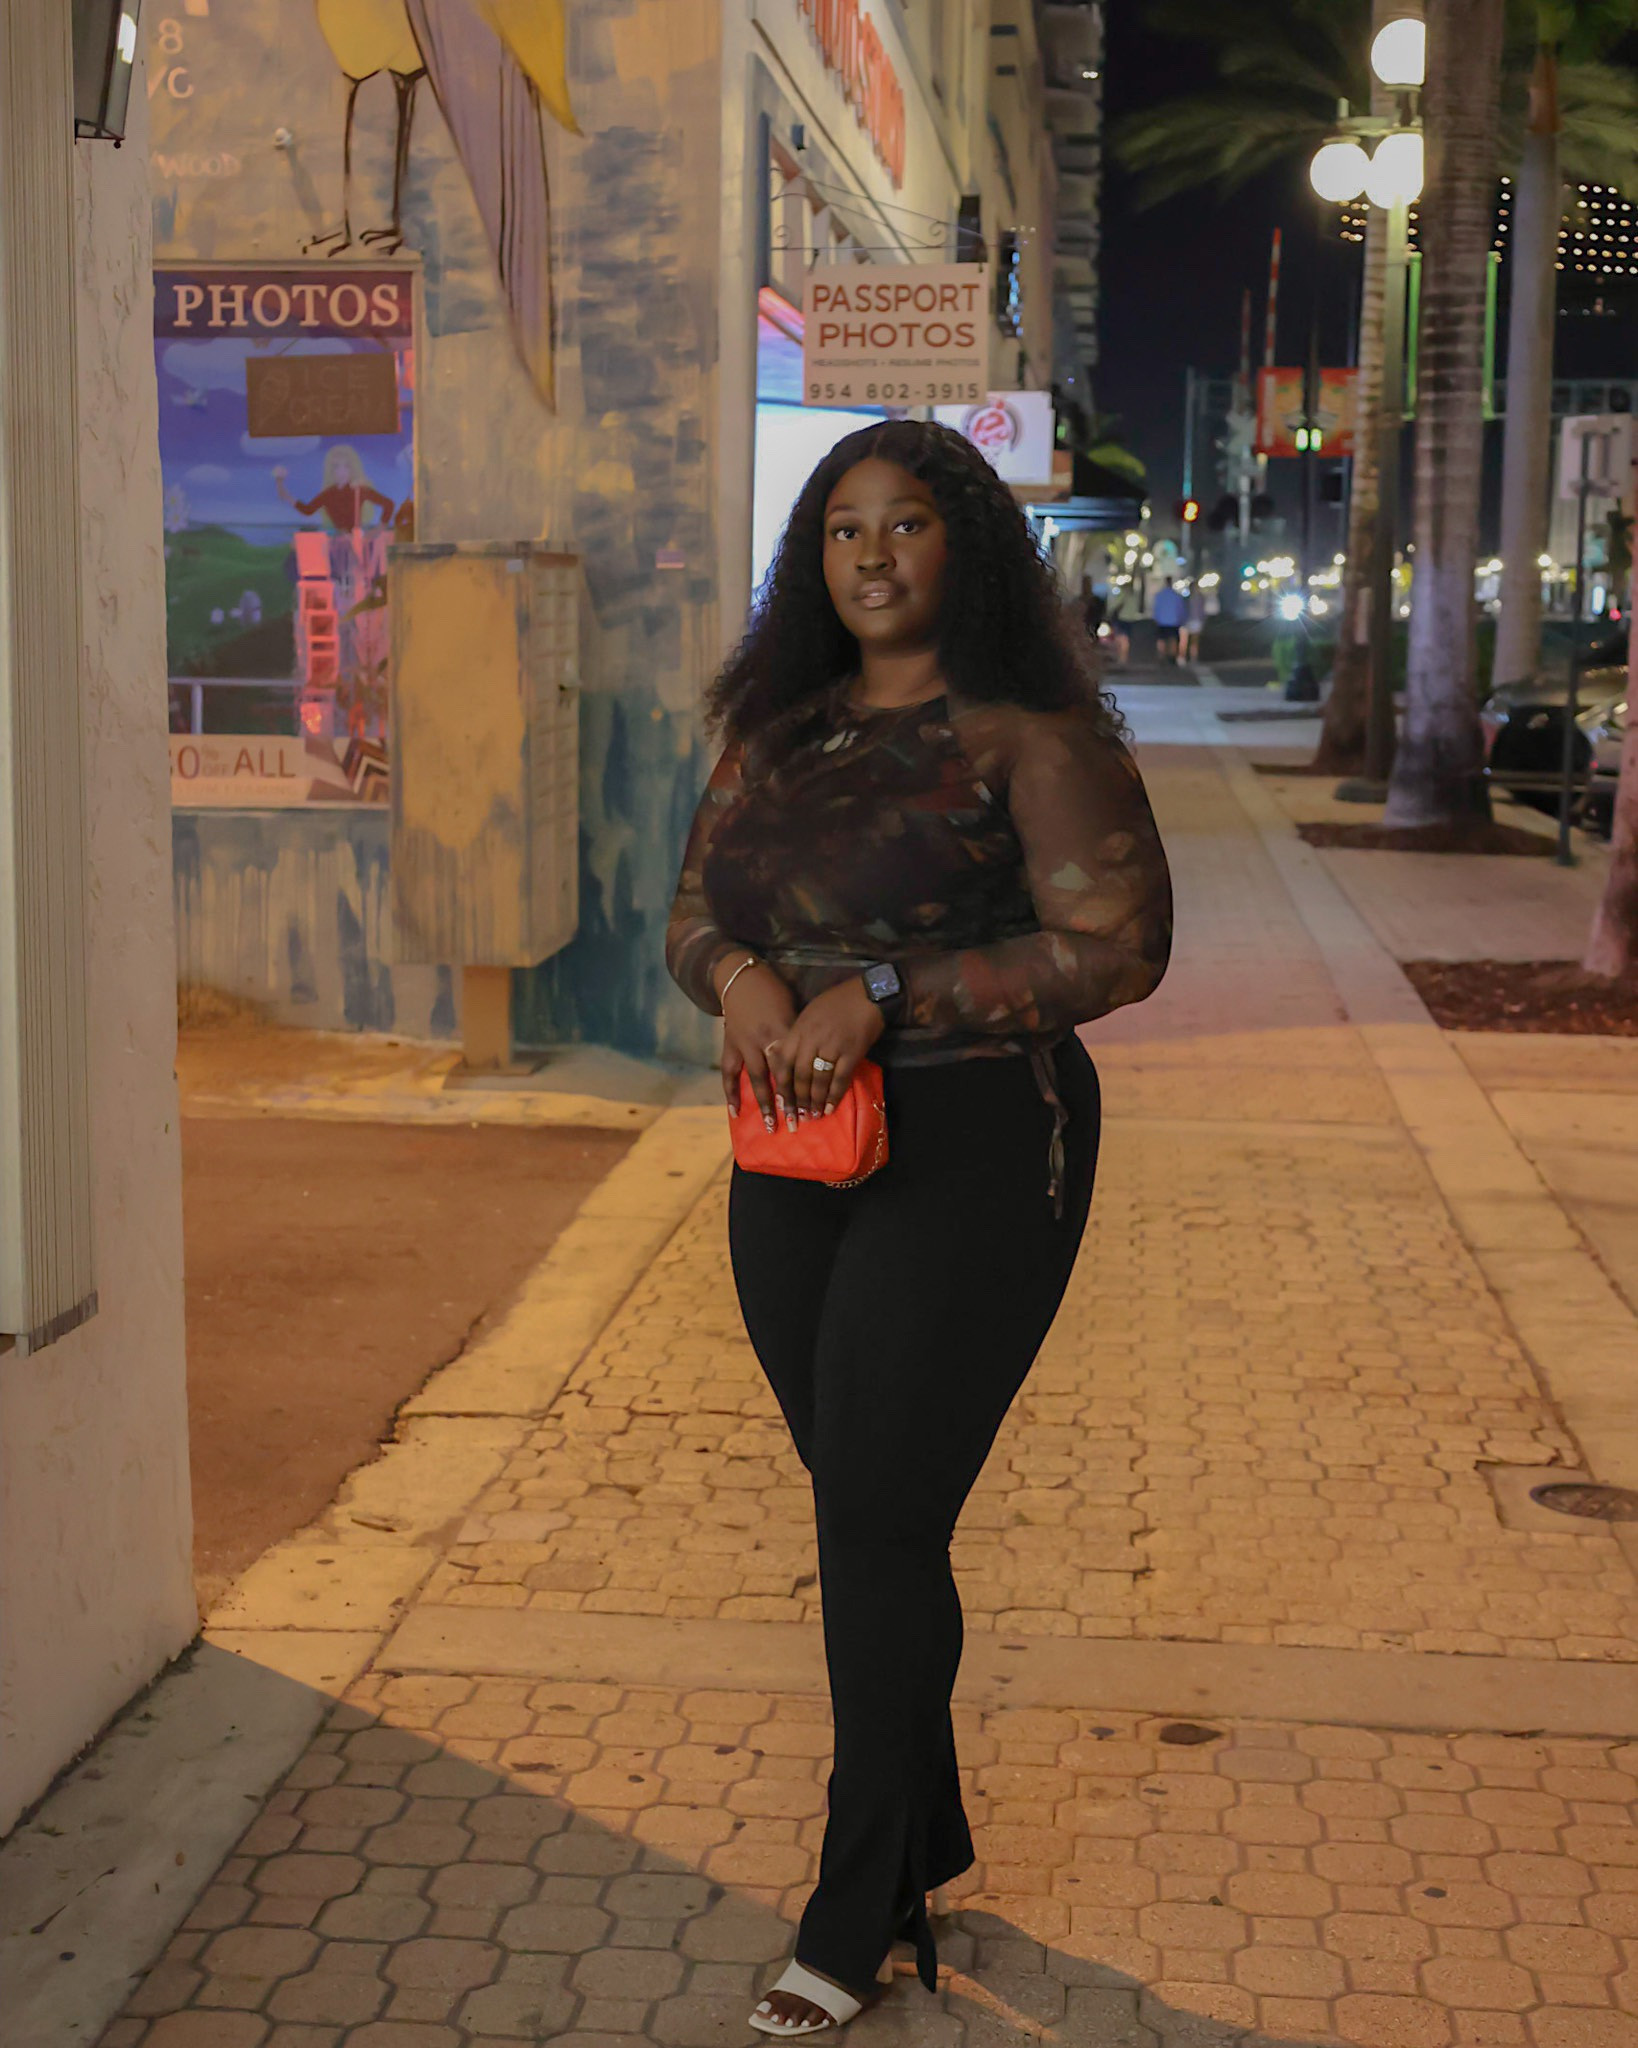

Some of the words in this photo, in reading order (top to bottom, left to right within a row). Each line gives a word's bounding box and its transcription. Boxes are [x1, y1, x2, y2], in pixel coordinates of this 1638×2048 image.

[172, 283, 401, 328] PHOTOS
[812, 283, 980, 313] PASSPORT
[818, 322, 976, 348] PHOTOS
[304, 363, 369, 391] ICE
[808, 383, 853, 399] 954
[866, 383, 979, 399] 802-3915
[234, 747, 297, 778] ALL
